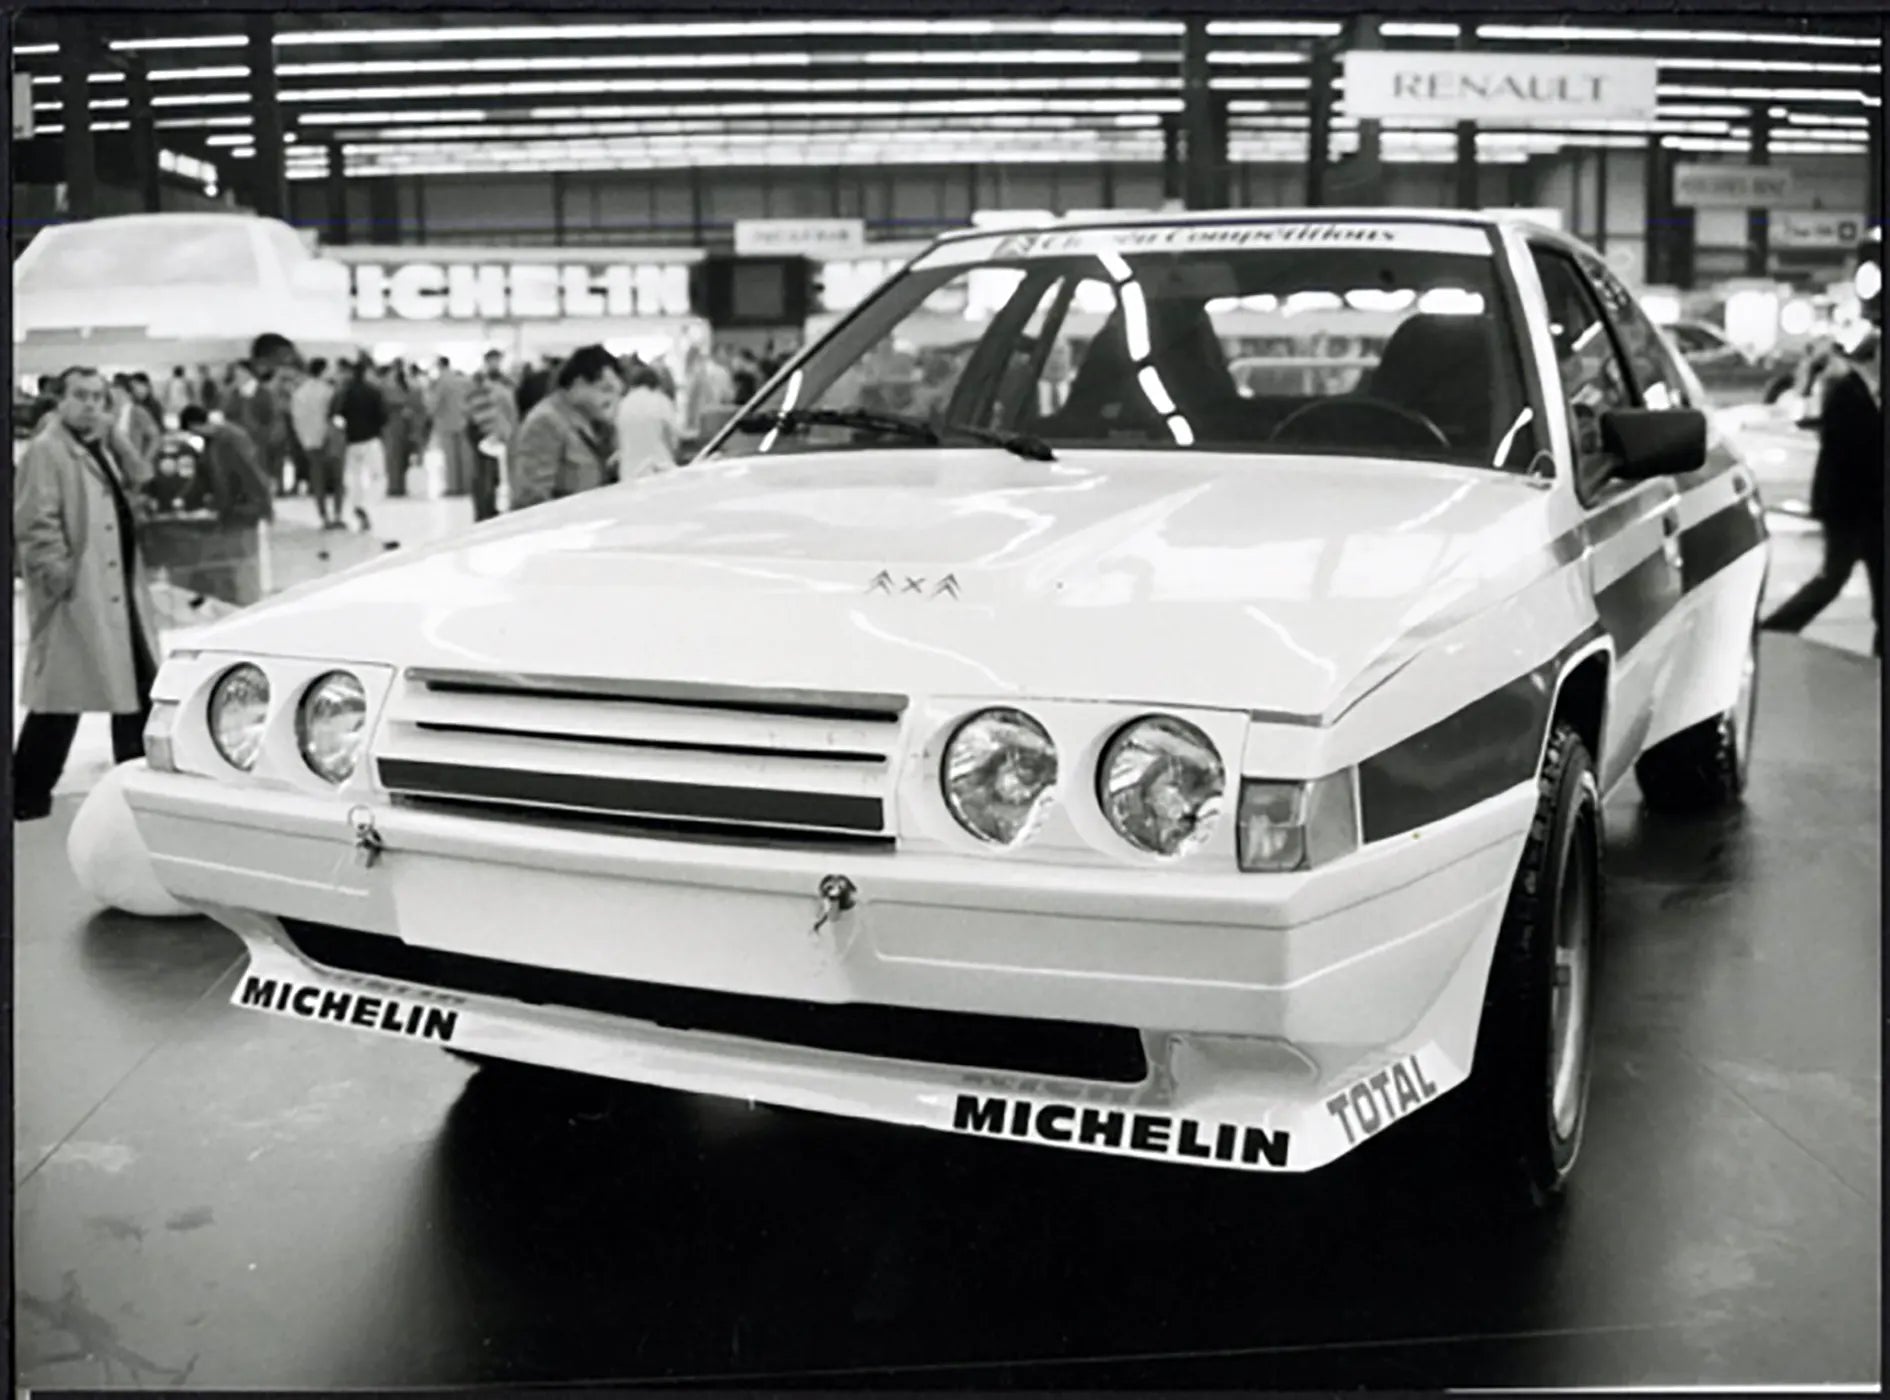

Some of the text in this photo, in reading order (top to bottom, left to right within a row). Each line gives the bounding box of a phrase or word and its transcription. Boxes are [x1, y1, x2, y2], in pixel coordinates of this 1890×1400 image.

[1392, 72, 1608, 101] RENAULT
[353, 262, 692, 320] ICHELIN
[240, 975, 458, 1042] MICHELIN
[953, 1093, 1291, 1168] MICHELIN
[1325, 1053, 1438, 1145] TOTAL
